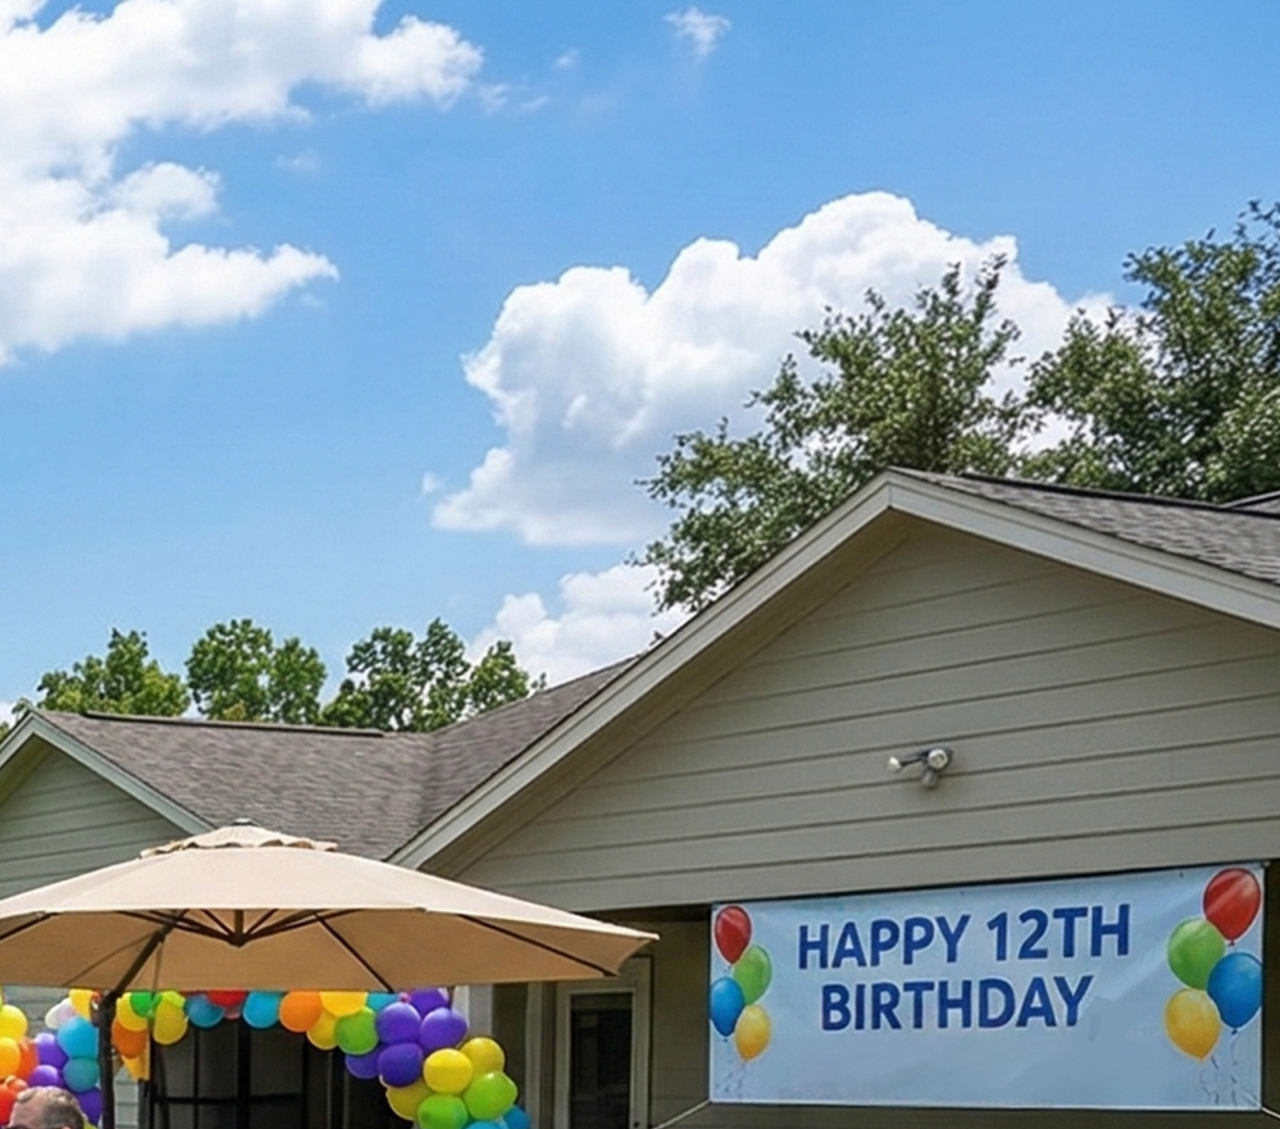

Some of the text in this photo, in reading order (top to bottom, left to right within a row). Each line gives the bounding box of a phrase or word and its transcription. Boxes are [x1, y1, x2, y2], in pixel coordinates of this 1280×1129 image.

[798, 903, 1131, 970] HAPPY 12TH
[821, 975, 1094, 1031] BIRTHDAY
